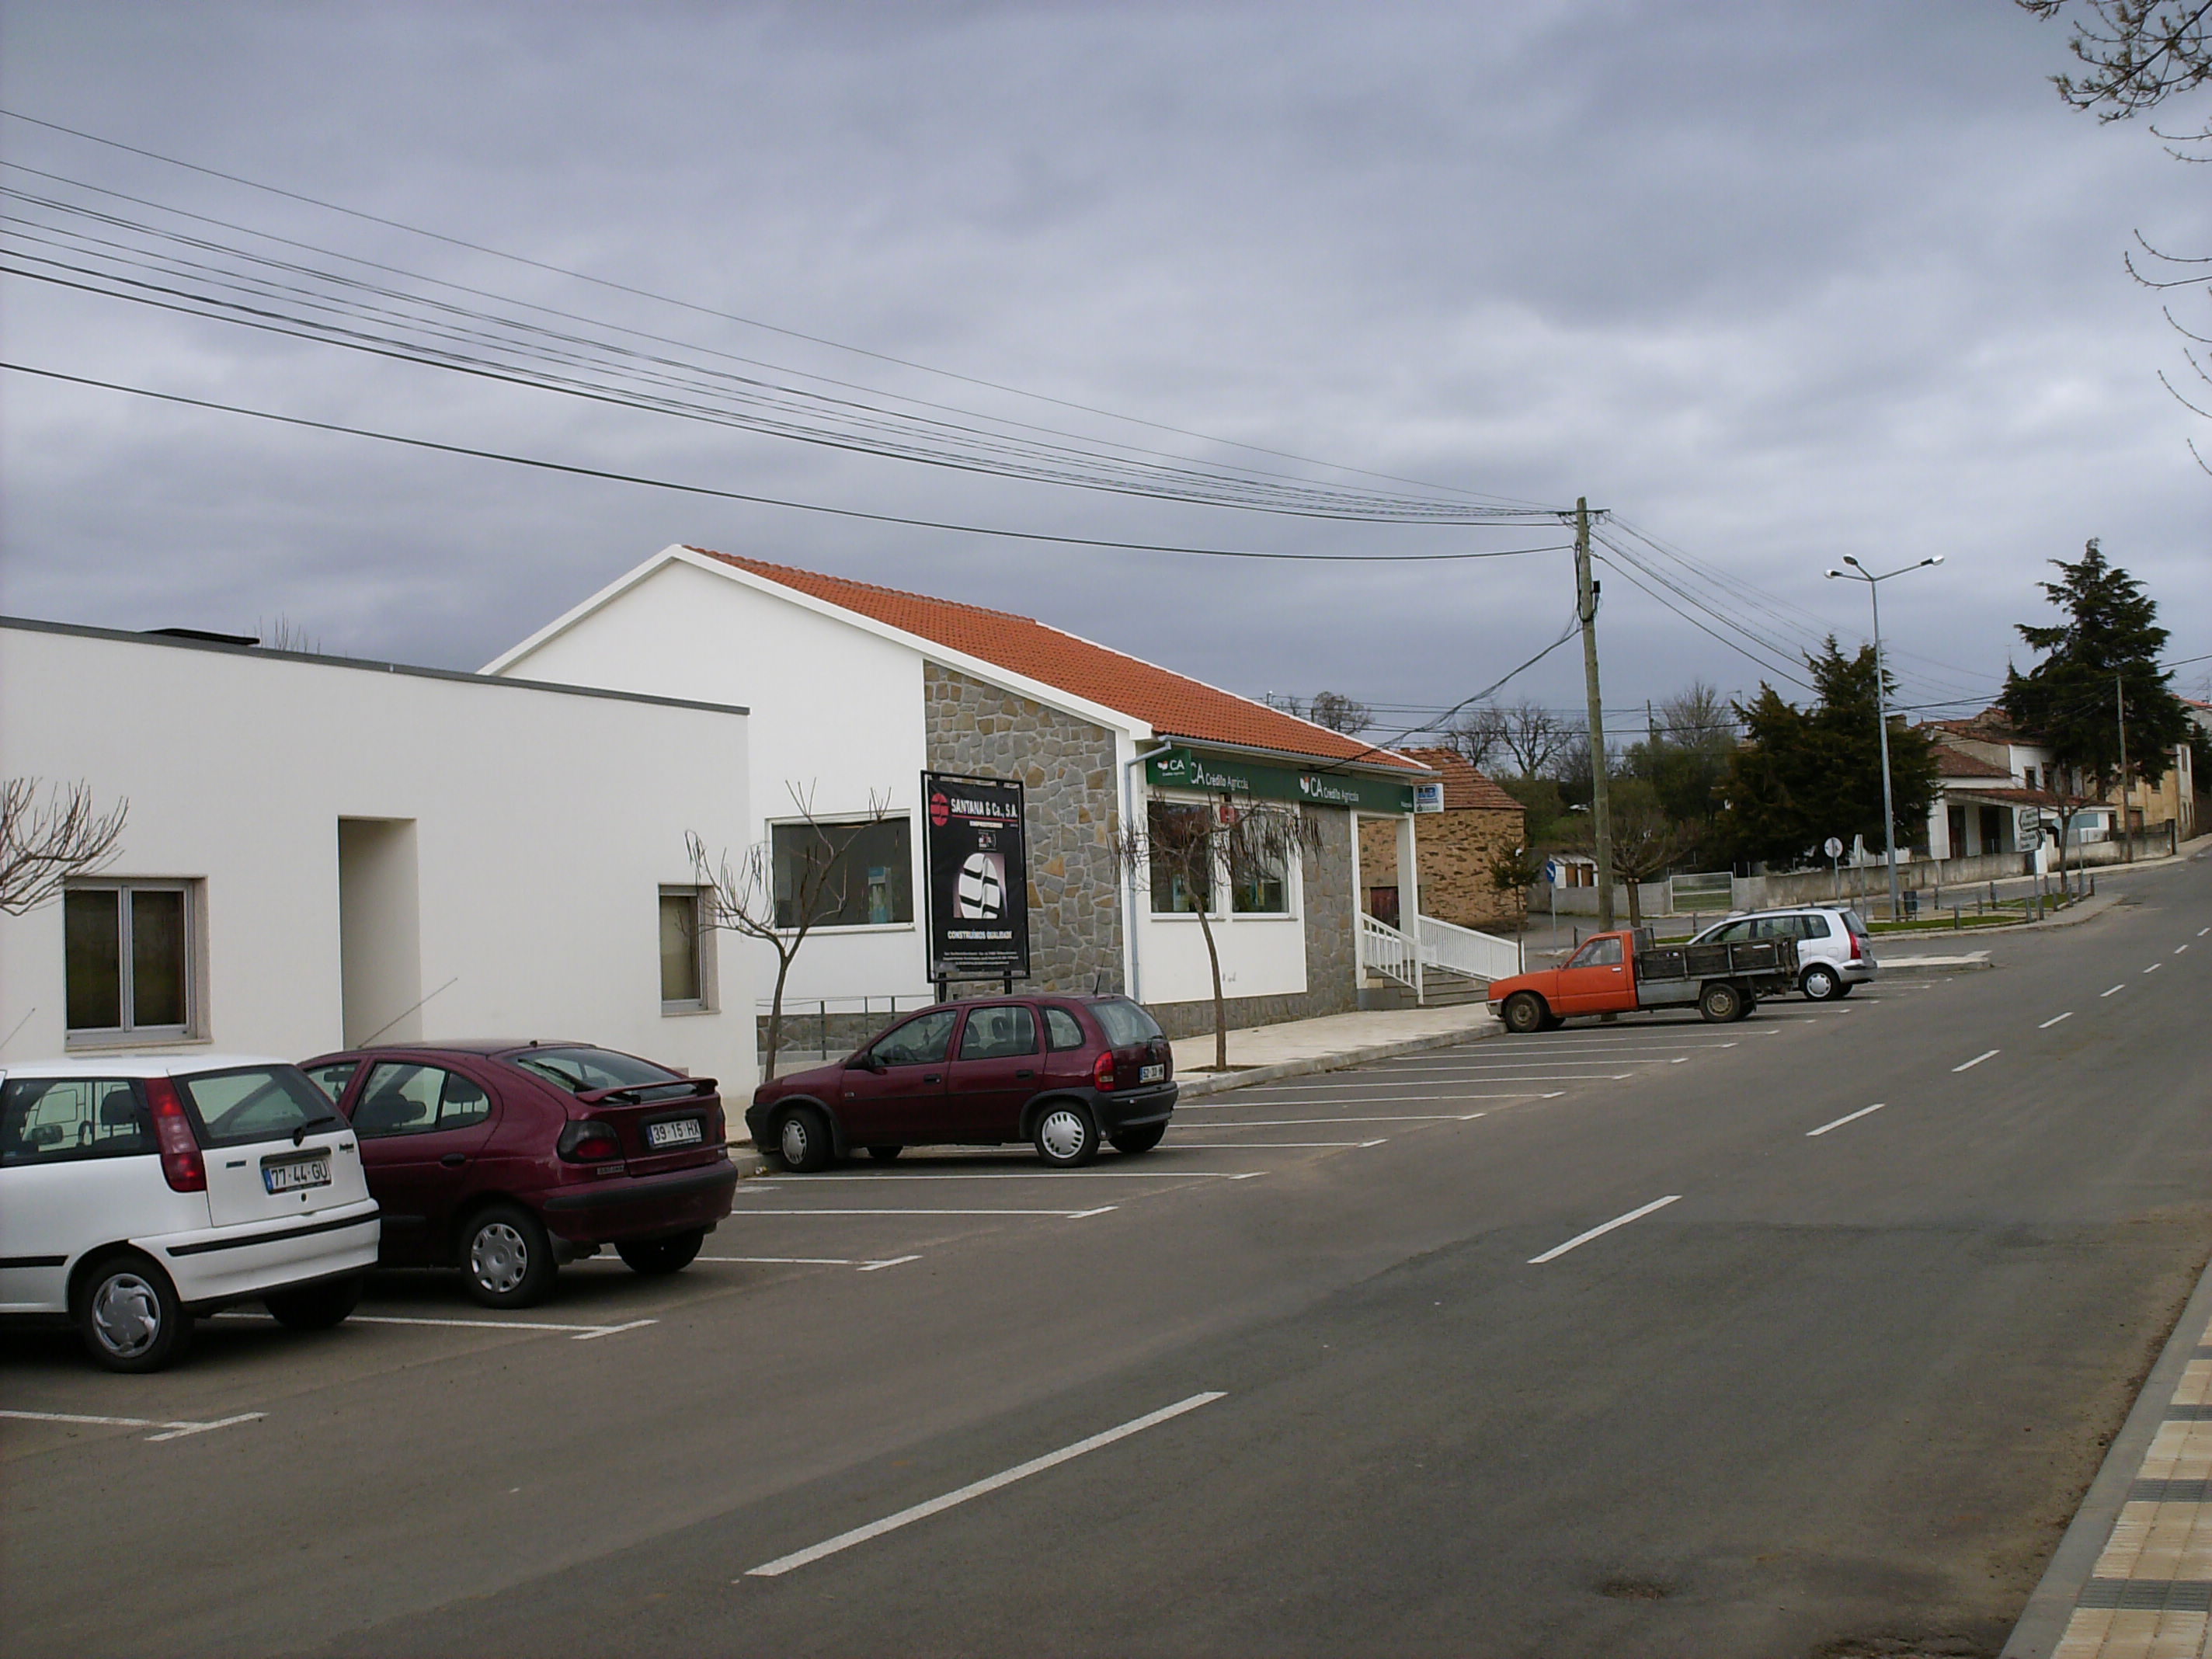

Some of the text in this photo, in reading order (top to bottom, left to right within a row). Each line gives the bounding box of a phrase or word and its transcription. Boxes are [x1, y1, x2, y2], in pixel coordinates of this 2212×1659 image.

[1170, 760, 1184, 770] CA
[1310, 777, 1323, 798] CA
[951, 798, 984, 816] SANTANA
